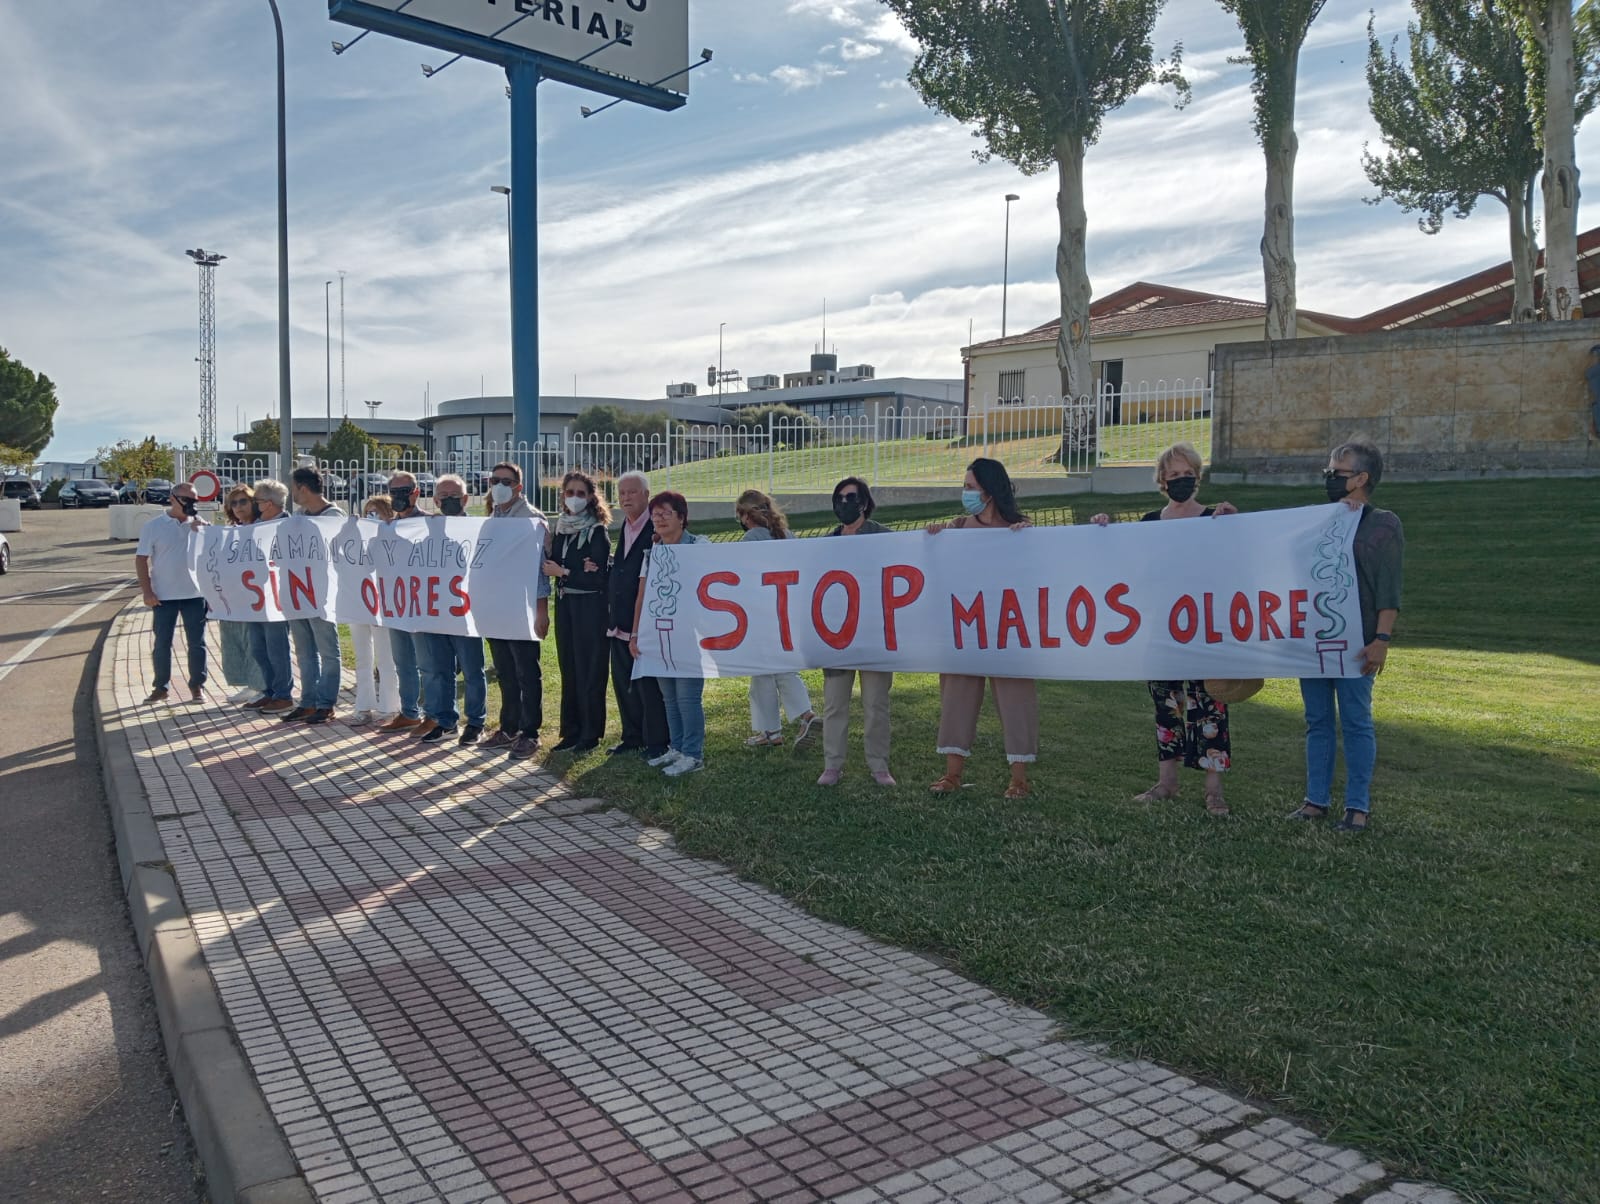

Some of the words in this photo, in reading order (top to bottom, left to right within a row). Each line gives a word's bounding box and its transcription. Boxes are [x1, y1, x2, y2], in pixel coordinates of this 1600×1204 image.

[227, 533, 375, 565] SALAMANCA
[382, 539, 397, 567] Y
[408, 538, 493, 569] ALFOZ
[361, 575, 471, 618] OLORES
[696, 564, 925, 651] STOP
[951, 582, 1141, 650] MALOS
[1168, 589, 1347, 645] OLORES
